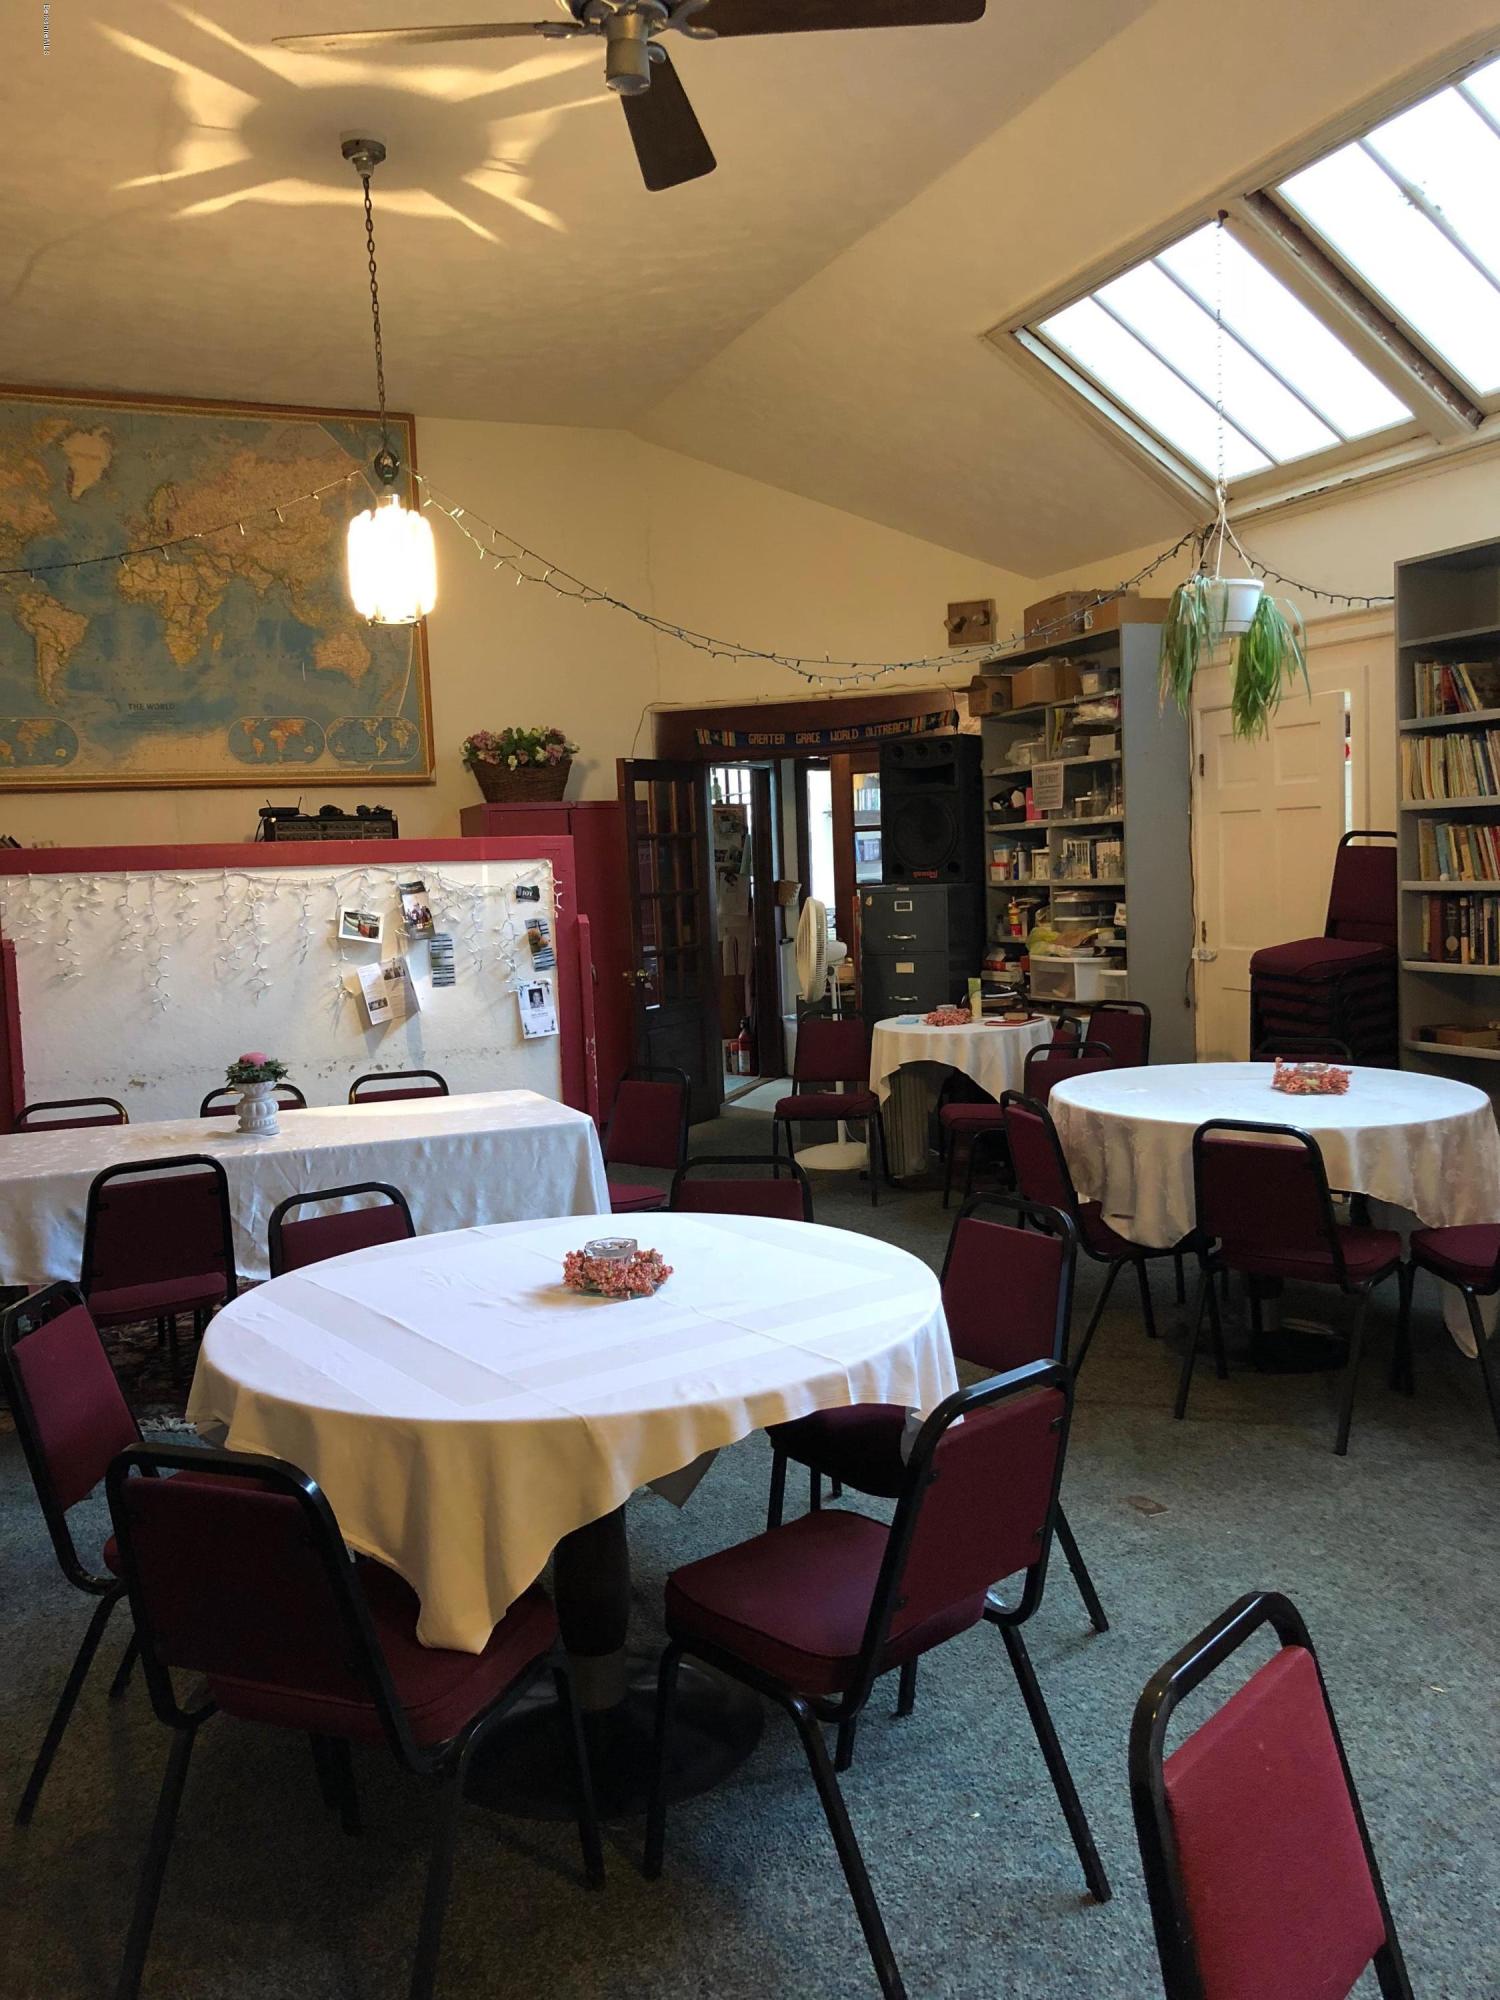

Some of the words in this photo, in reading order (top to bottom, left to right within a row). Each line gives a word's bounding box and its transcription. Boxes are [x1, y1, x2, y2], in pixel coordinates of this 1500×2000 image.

[128, 703, 145, 711] THE
[147, 703, 176, 711] WORLD
[748, 733, 785, 745] GREATER
[795, 731, 821, 744] GRACE
[829, 728, 859, 742] WORLD
[865, 721, 910, 738] OUTREACH
